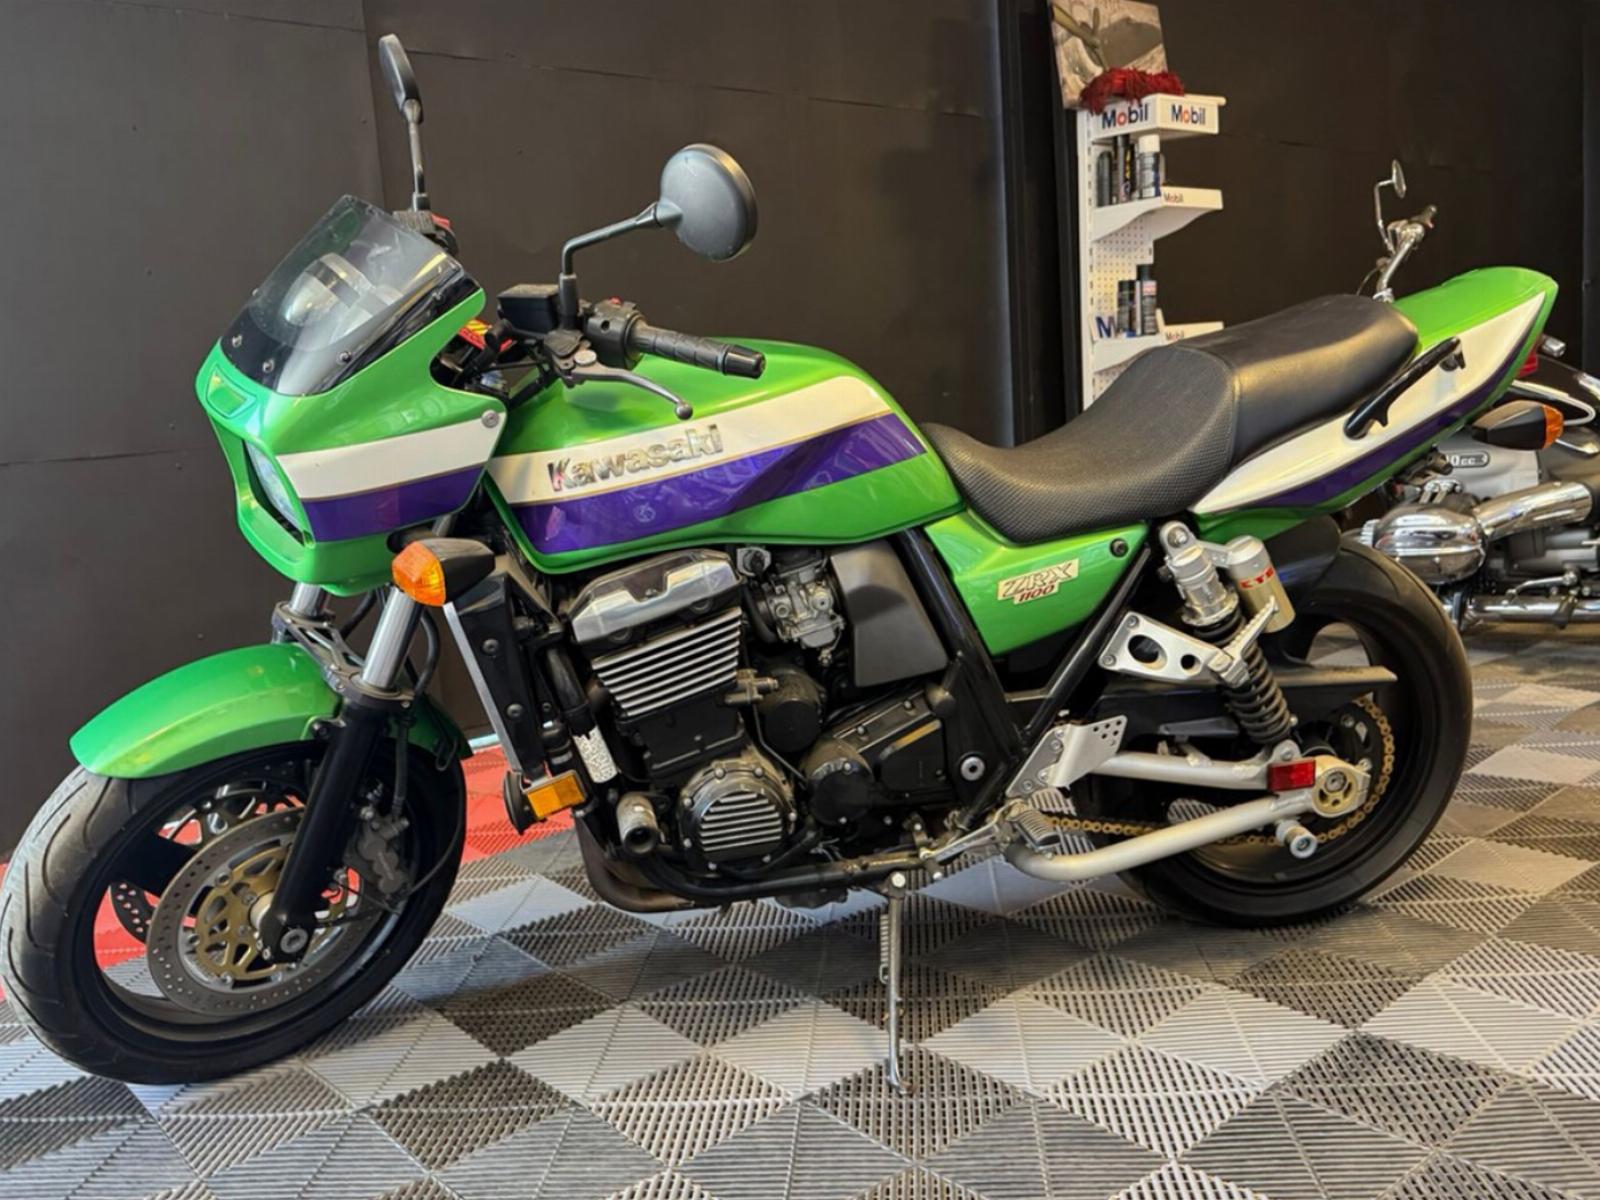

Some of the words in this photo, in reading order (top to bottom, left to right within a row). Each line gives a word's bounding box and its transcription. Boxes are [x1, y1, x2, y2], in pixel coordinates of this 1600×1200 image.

[1102, 102, 1149, 129] Mobil
[1170, 104, 1206, 125] Mobil
[547, 423, 724, 492] Kawasaki
[1002, 562, 1073, 598] ZRX
[1018, 583, 1056, 602] 1100
